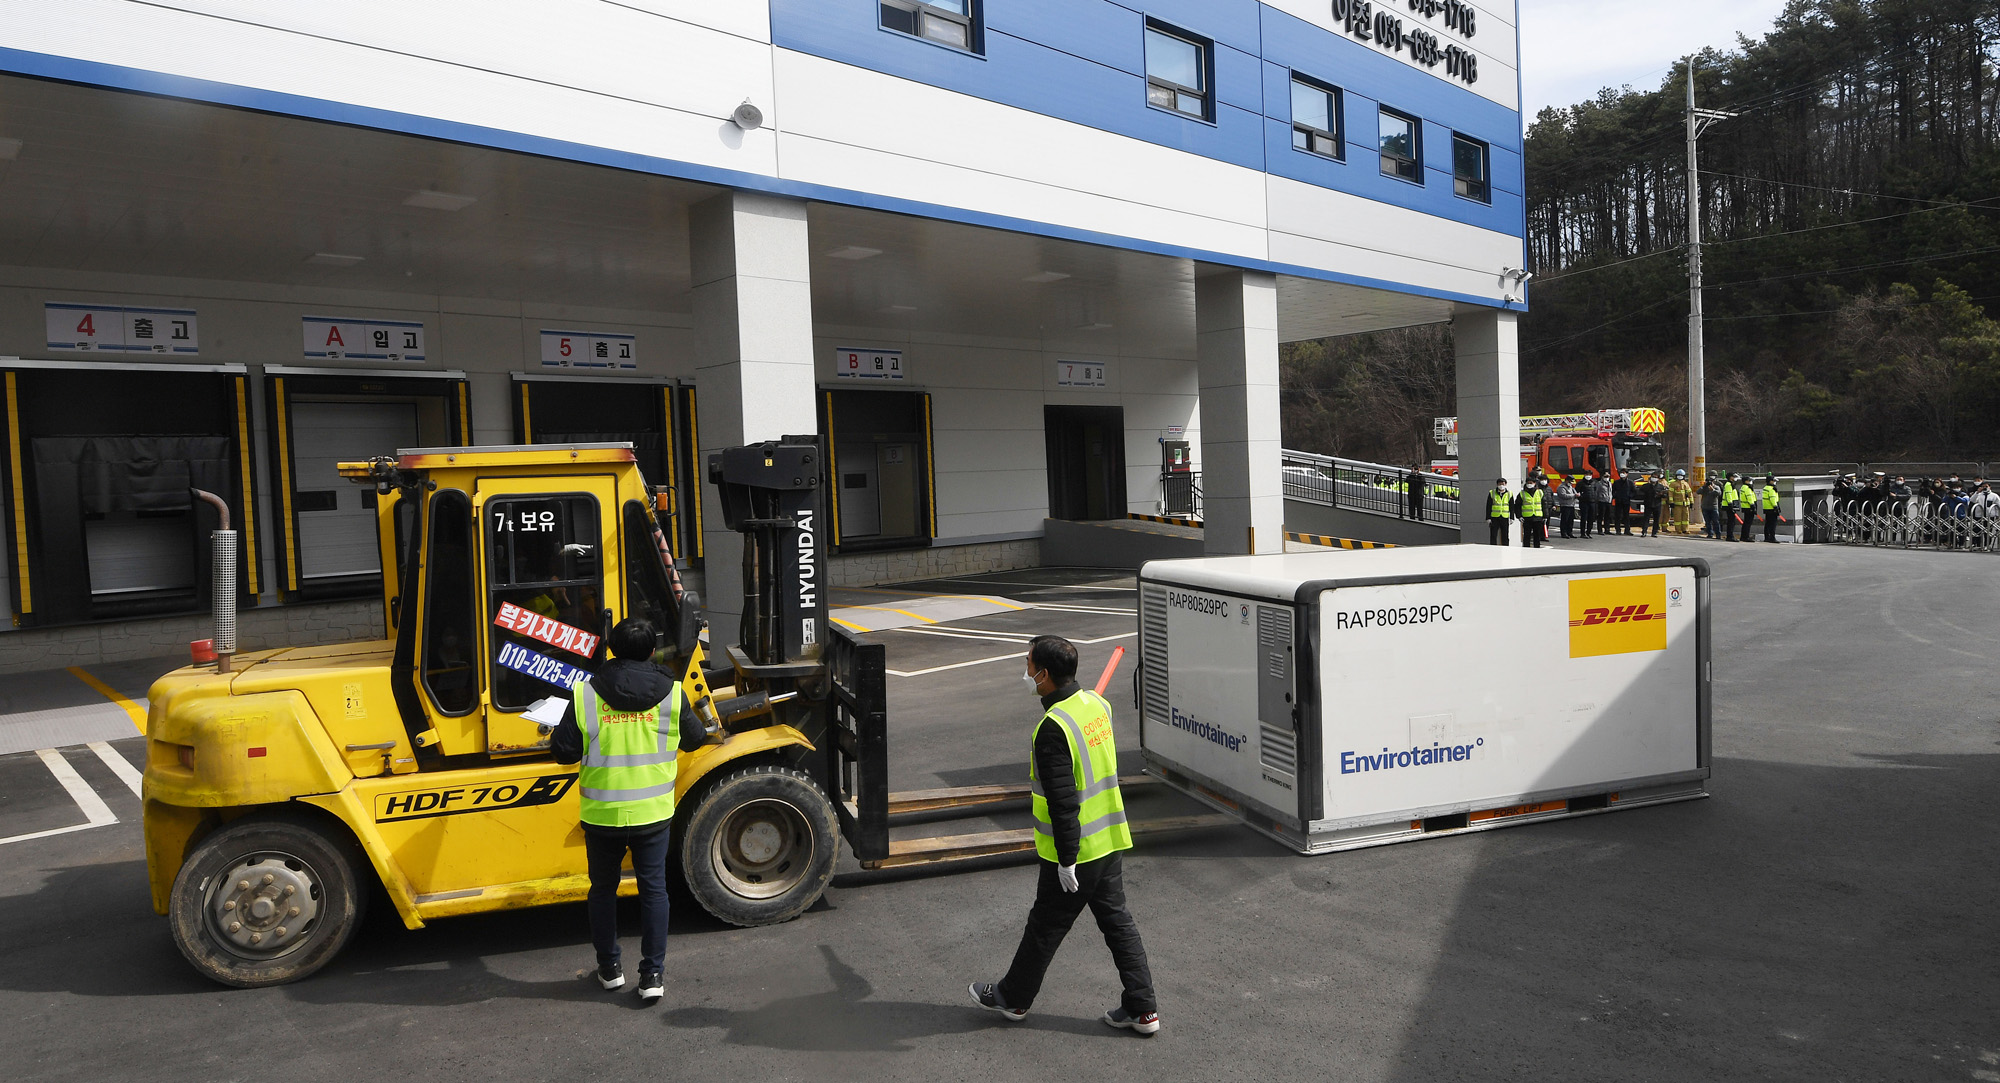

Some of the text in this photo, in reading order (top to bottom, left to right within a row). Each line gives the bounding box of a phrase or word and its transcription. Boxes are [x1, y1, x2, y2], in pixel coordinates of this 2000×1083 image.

[1332, 0, 1478, 84] 이천 031-633-1718
[76, 313, 95, 336] 4
[326, 326, 344, 346] A
[560, 338, 572, 356] 5
[849, 353, 859, 369] B
[1066, 365, 1073, 379] 7
[520, 511, 556, 533] 보유
[797, 509, 816, 608] HYUNDAI
[1169, 591, 1228, 618] RAP80529PC
[1582, 604, 1654, 626] DHL
[1336, 604, 1453, 630] RAP80529PC
[498, 602, 597, 657] 럭키지게차
[498, 643, 595, 691] 010-2025-48
[385, 788, 465, 815] HDF
[472, 785, 520, 805] 70
[1493, 803, 1544, 818] FORK LIFT
